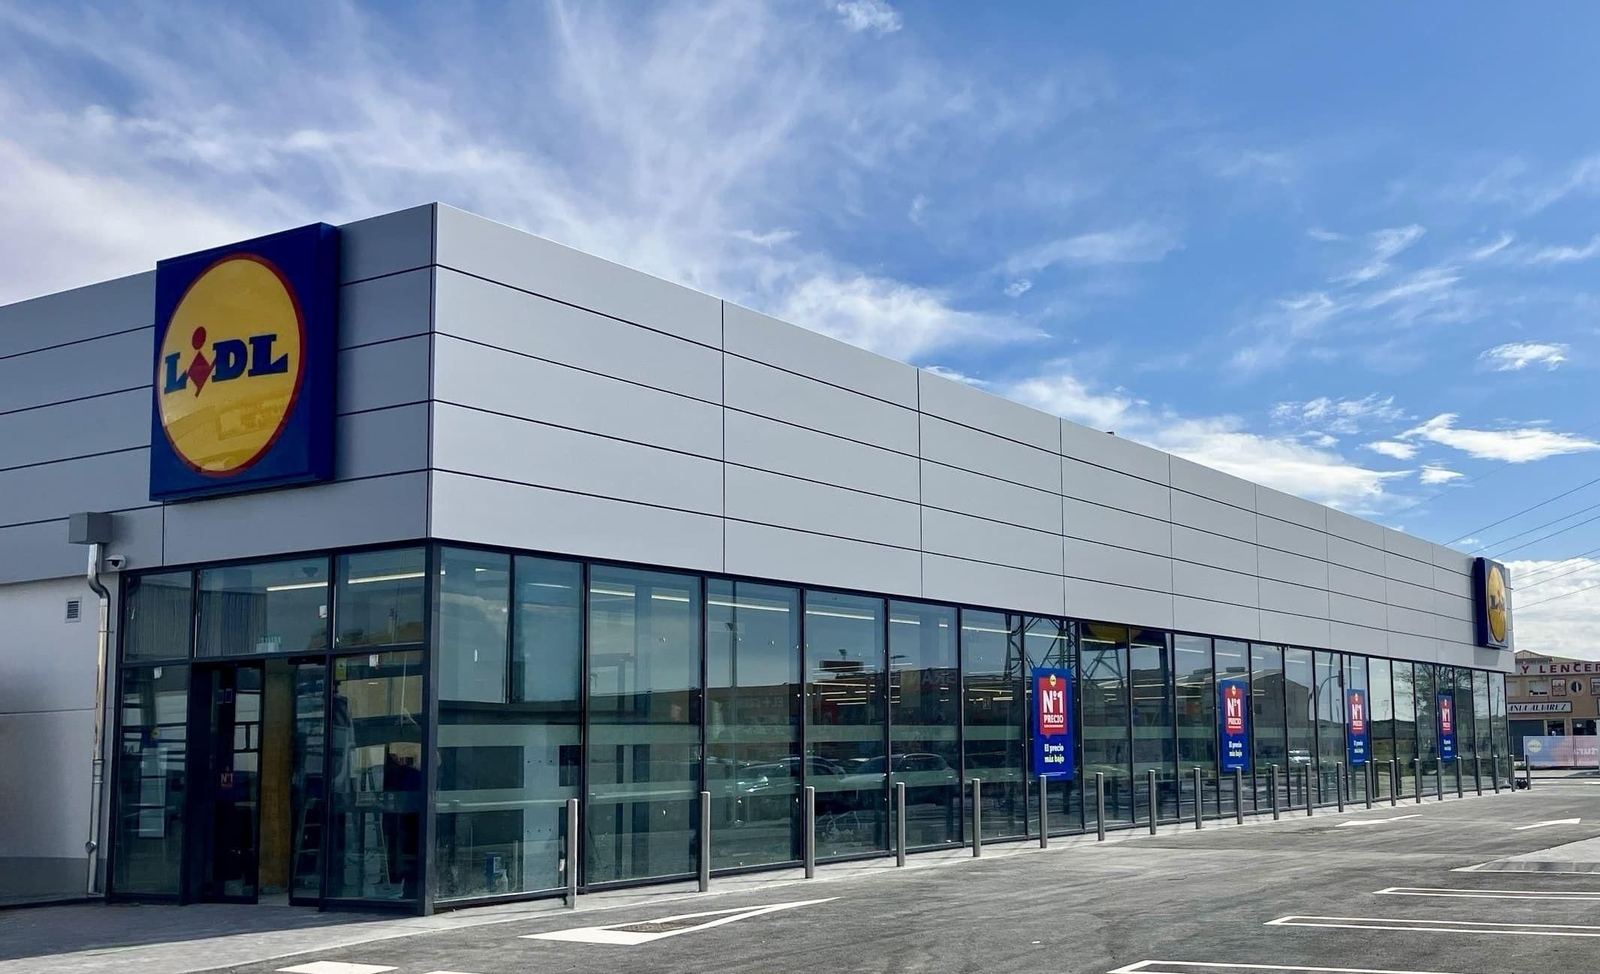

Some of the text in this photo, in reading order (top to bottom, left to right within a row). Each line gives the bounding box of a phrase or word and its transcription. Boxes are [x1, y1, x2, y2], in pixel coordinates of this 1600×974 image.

[1521, 665, 1530, 674] Y
[1043, 714, 1064, 724] PRECIO
[1050, 742, 1065, 754] precio
